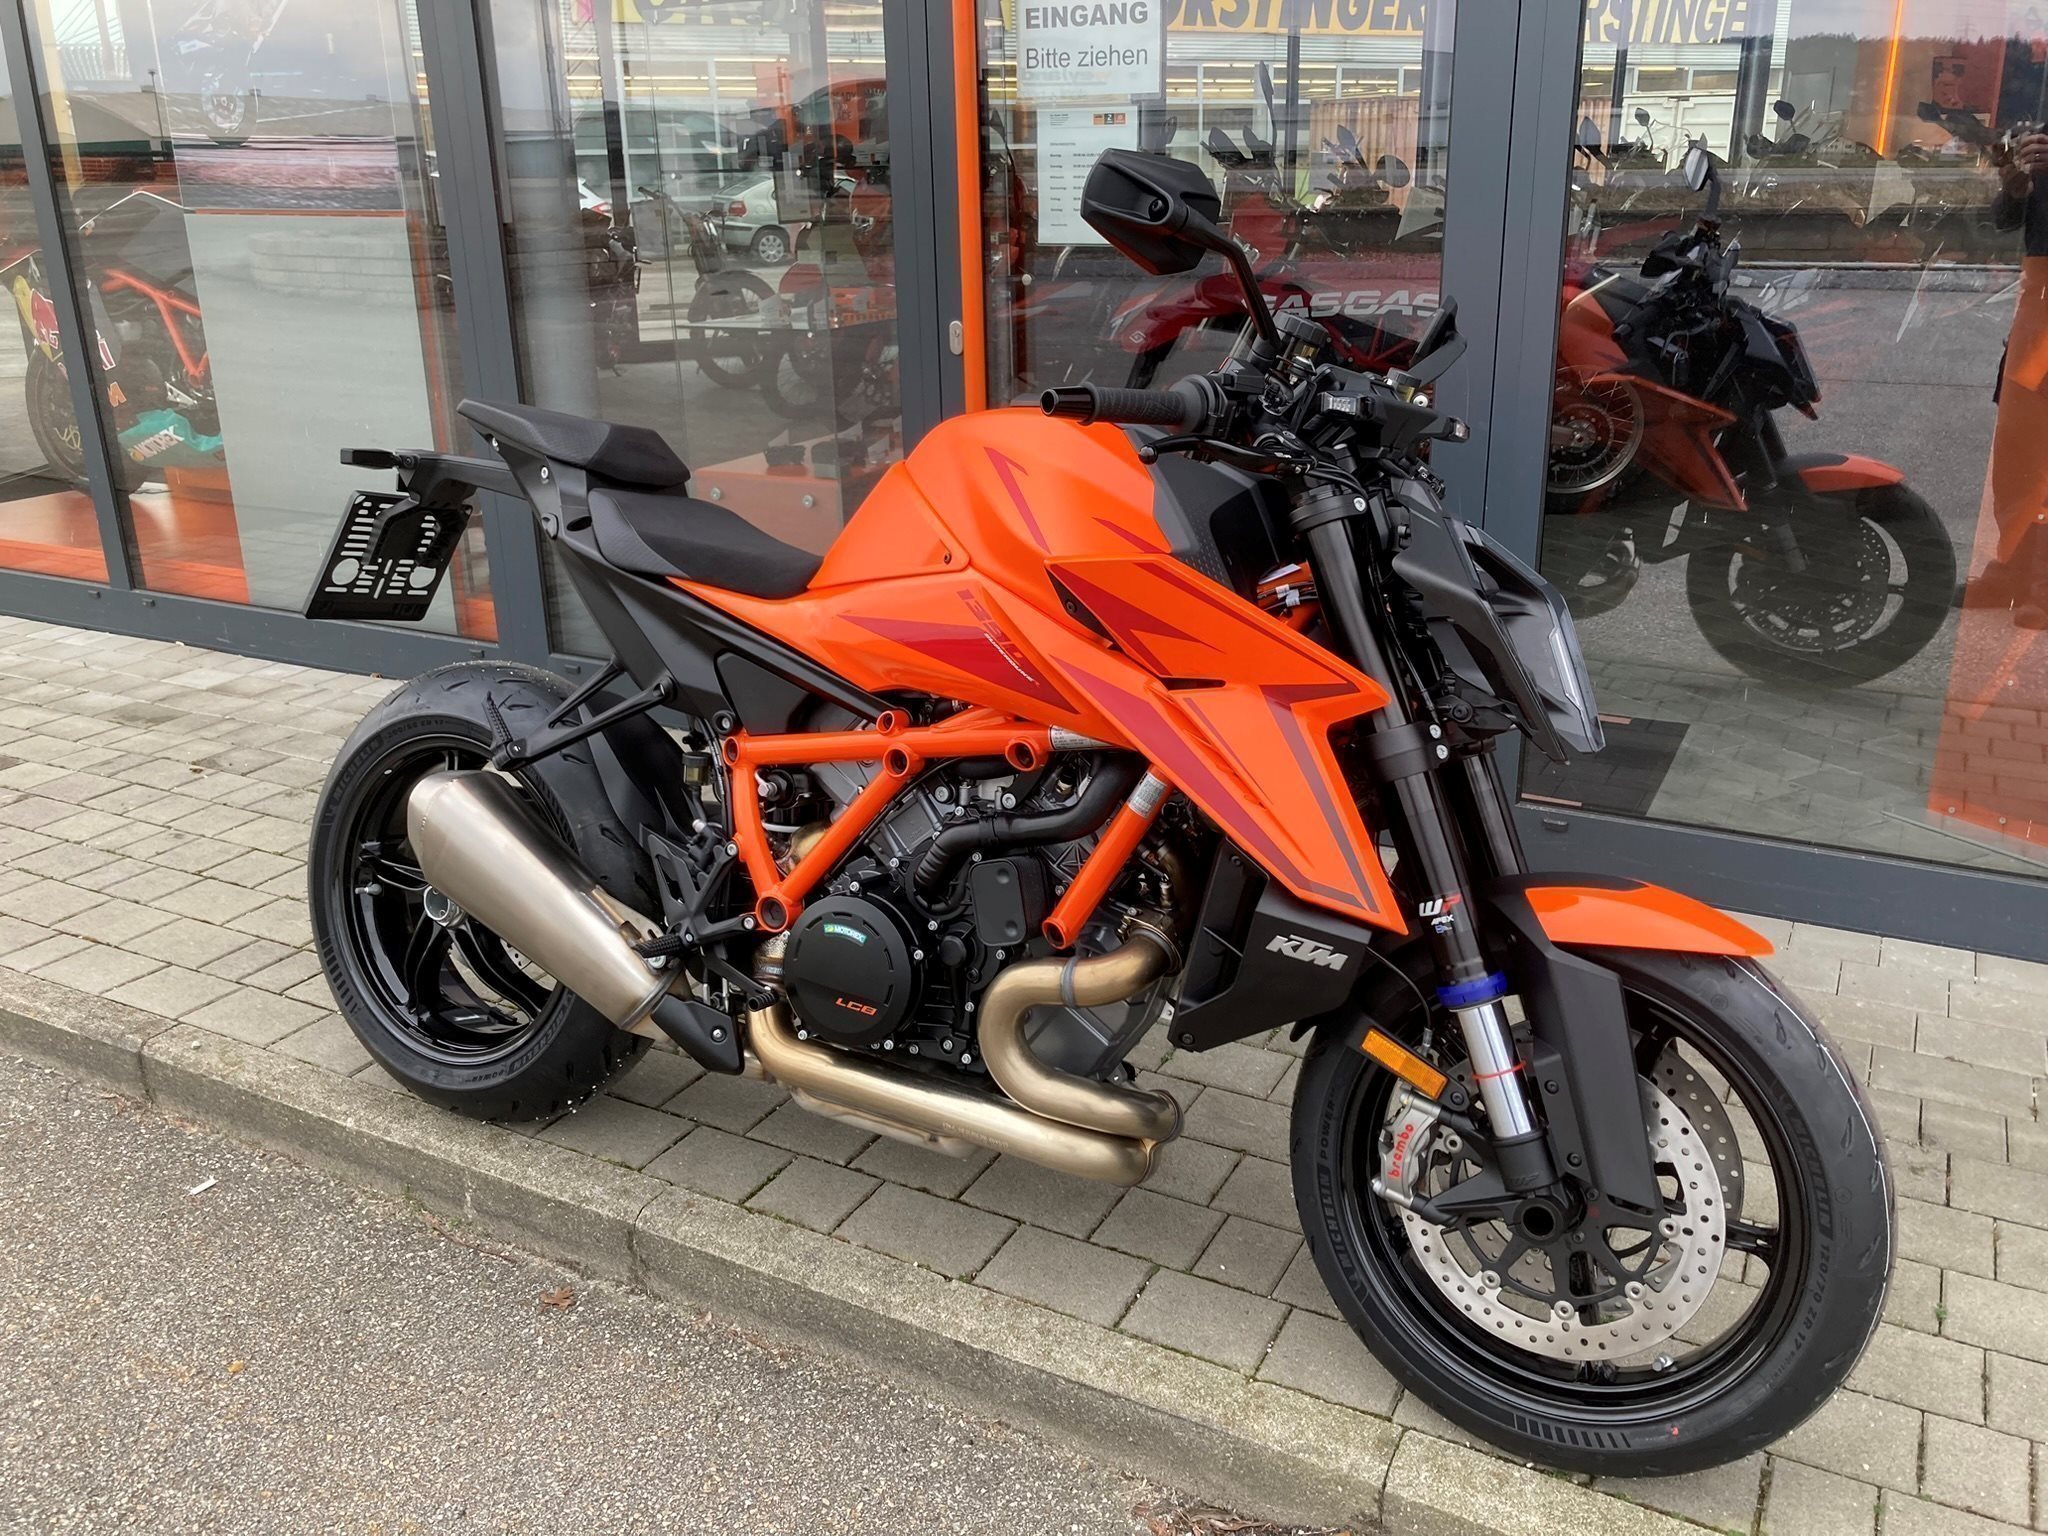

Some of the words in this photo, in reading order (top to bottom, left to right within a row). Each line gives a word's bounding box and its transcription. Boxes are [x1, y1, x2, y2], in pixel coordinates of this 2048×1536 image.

[1025, 1, 1148, 30] EINGANG
[1026, 47, 1071, 70] Bitte
[1077, 45, 1148, 67] ziehen
[332, 739, 381, 803] MICHELIN
[1418, 893, 1461, 917] WP
[834, 923, 865, 943] MOTOREX
[1265, 933, 1349, 971] KTM
[1387, 1123, 1415, 1179] brembo
[1793, 1116, 1833, 1229] MICHELIN
[1318, 1173, 1353, 1270] MICHELIN
[1812, 1243, 1831, 1304] 120/70
[1802, 1306, 1818, 1330] ZR
[1793, 1331, 1807, 1351] 17
